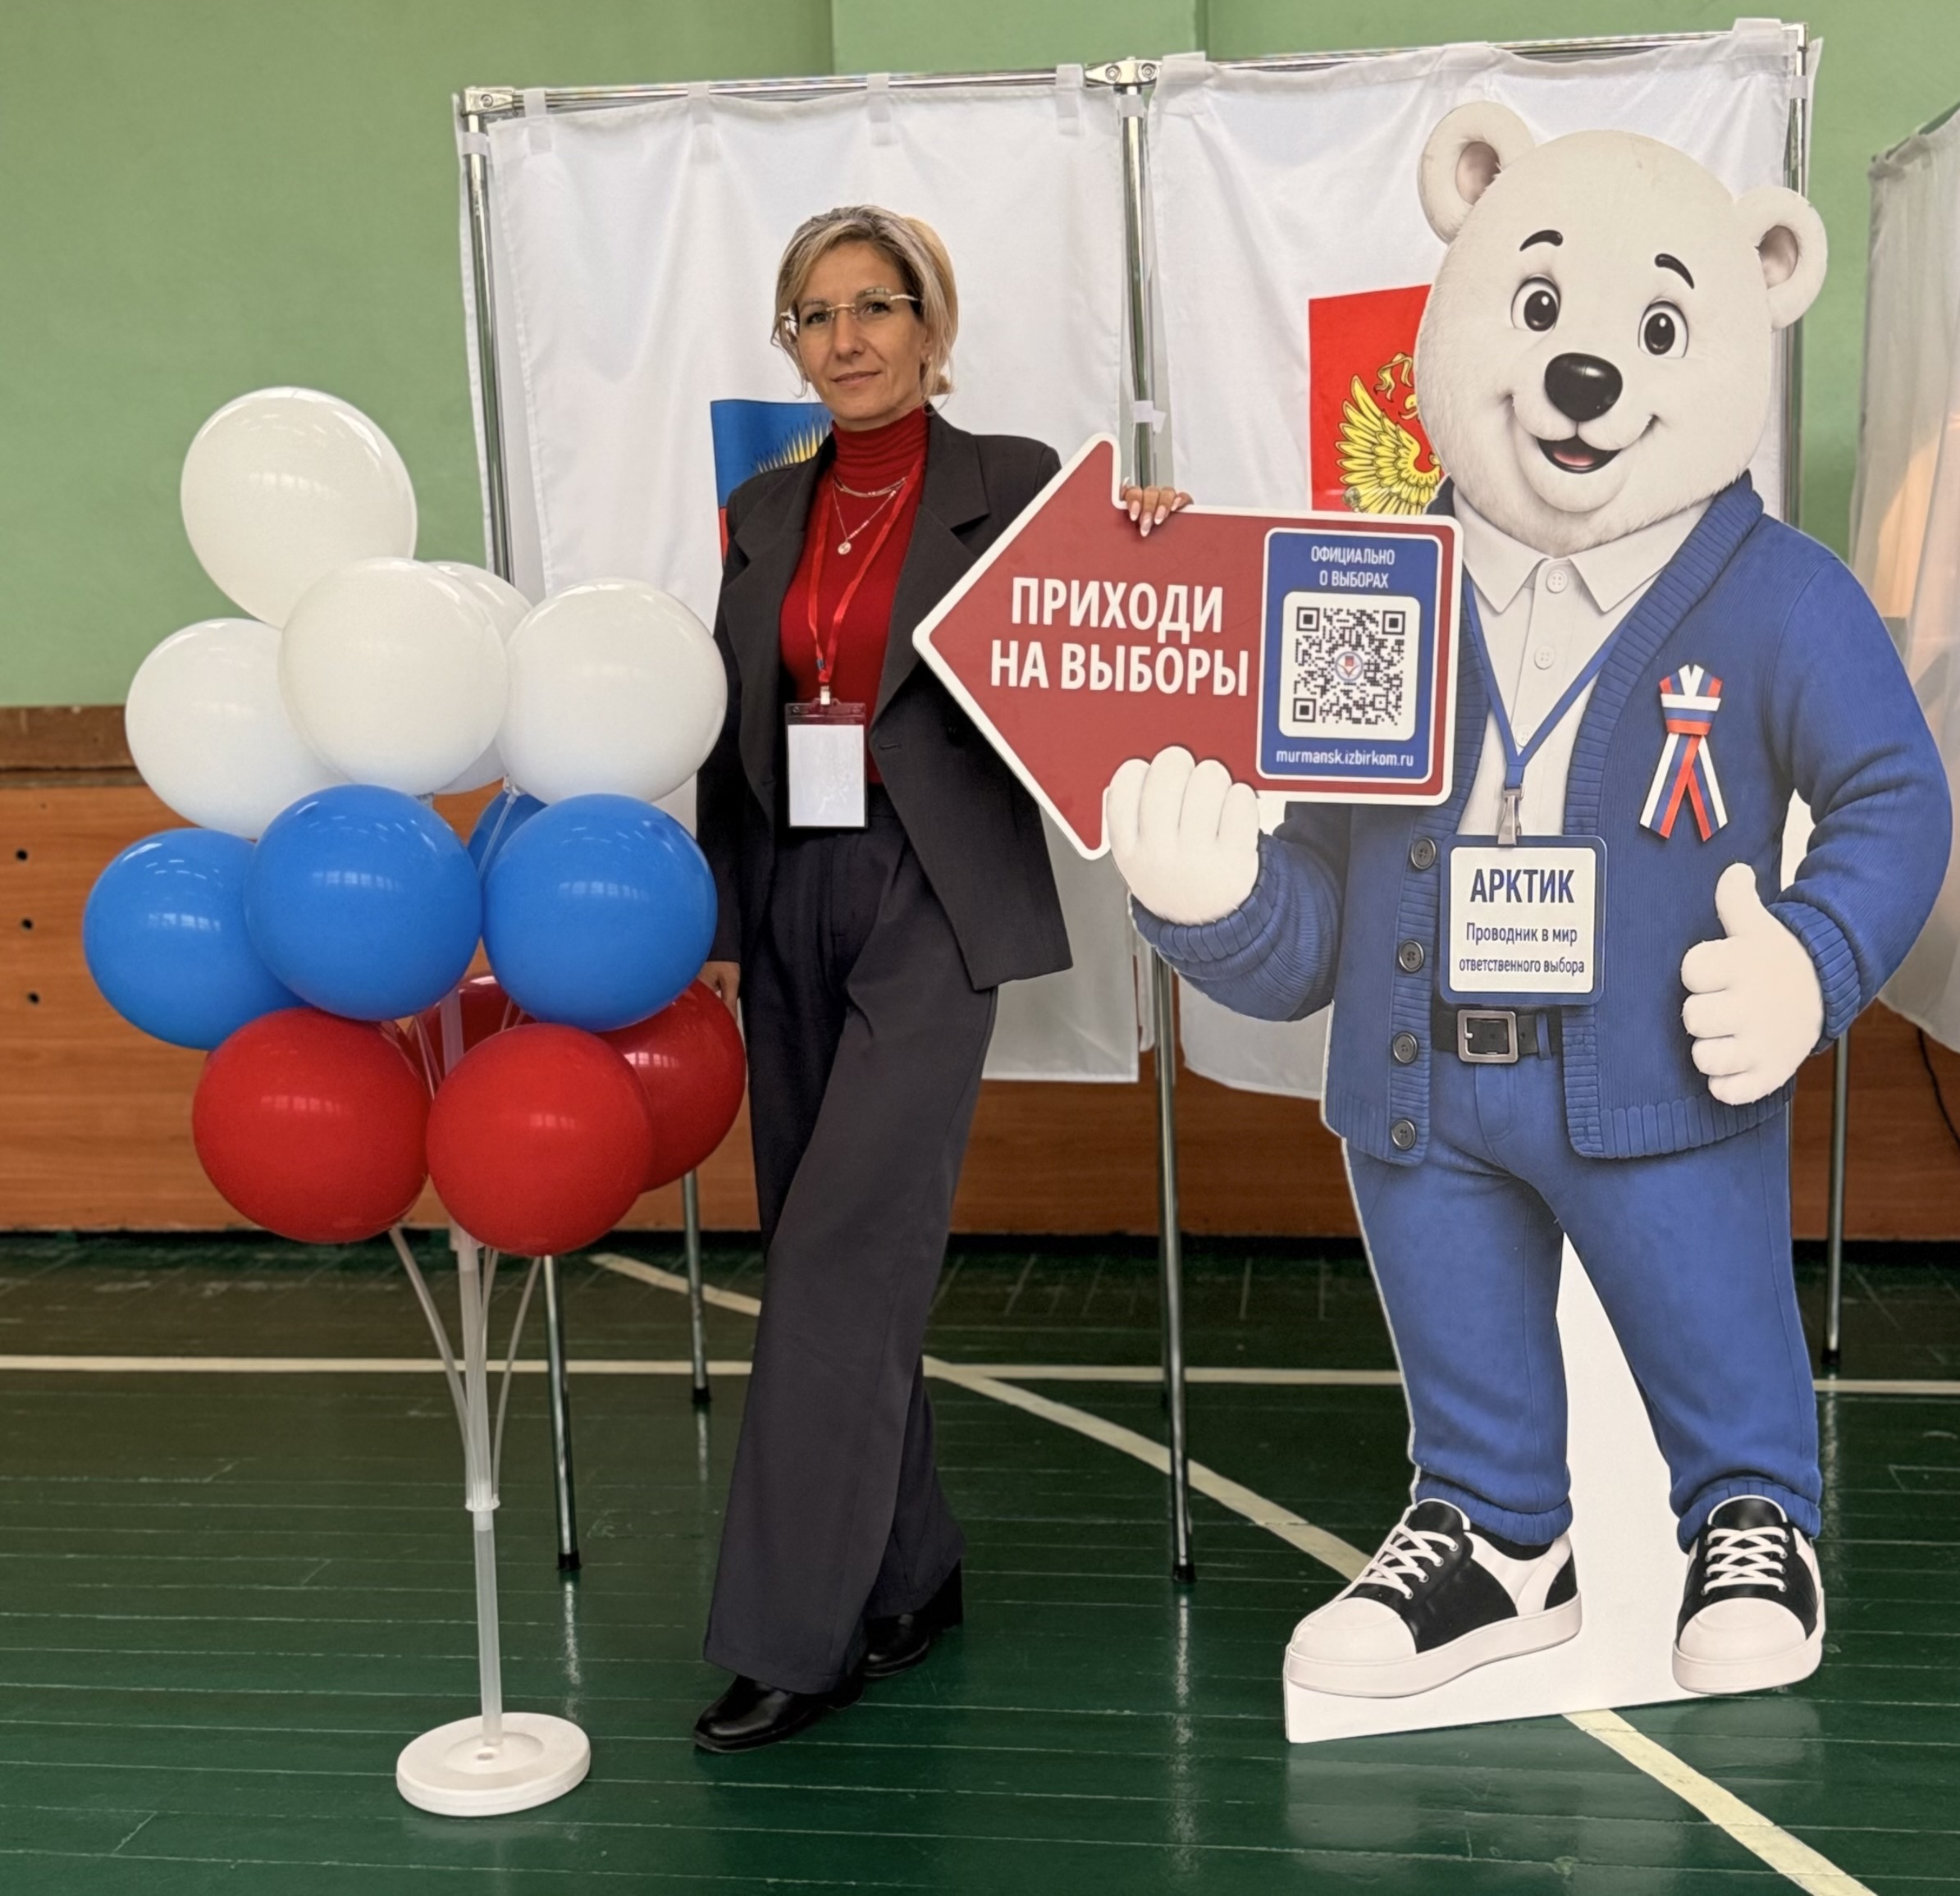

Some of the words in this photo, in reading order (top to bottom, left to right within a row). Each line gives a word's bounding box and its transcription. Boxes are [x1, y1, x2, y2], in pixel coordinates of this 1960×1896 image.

[1311, 546, 1395, 565] ОФИЦИАЛЬНО
[1319, 569, 1327, 585] О
[1332, 570, 1388, 588] ВЫБОРАХ
[1012, 577, 1222, 643] ПРИХОДИ
[990, 640, 1049, 688] НА
[1062, 643, 1249, 696] ВЫБОРЫ
[1276, 748, 1414, 768] murmansk.izbirkom.ru
[1469, 868, 1574, 902] АРКТИК
[1466, 922, 1538, 944] Проводник
[1542, 929, 1548, 942] в
[1552, 928, 1577, 946] мир
[1459, 958, 1541, 973] ответственного
[1543, 957, 1584, 976] выбора
